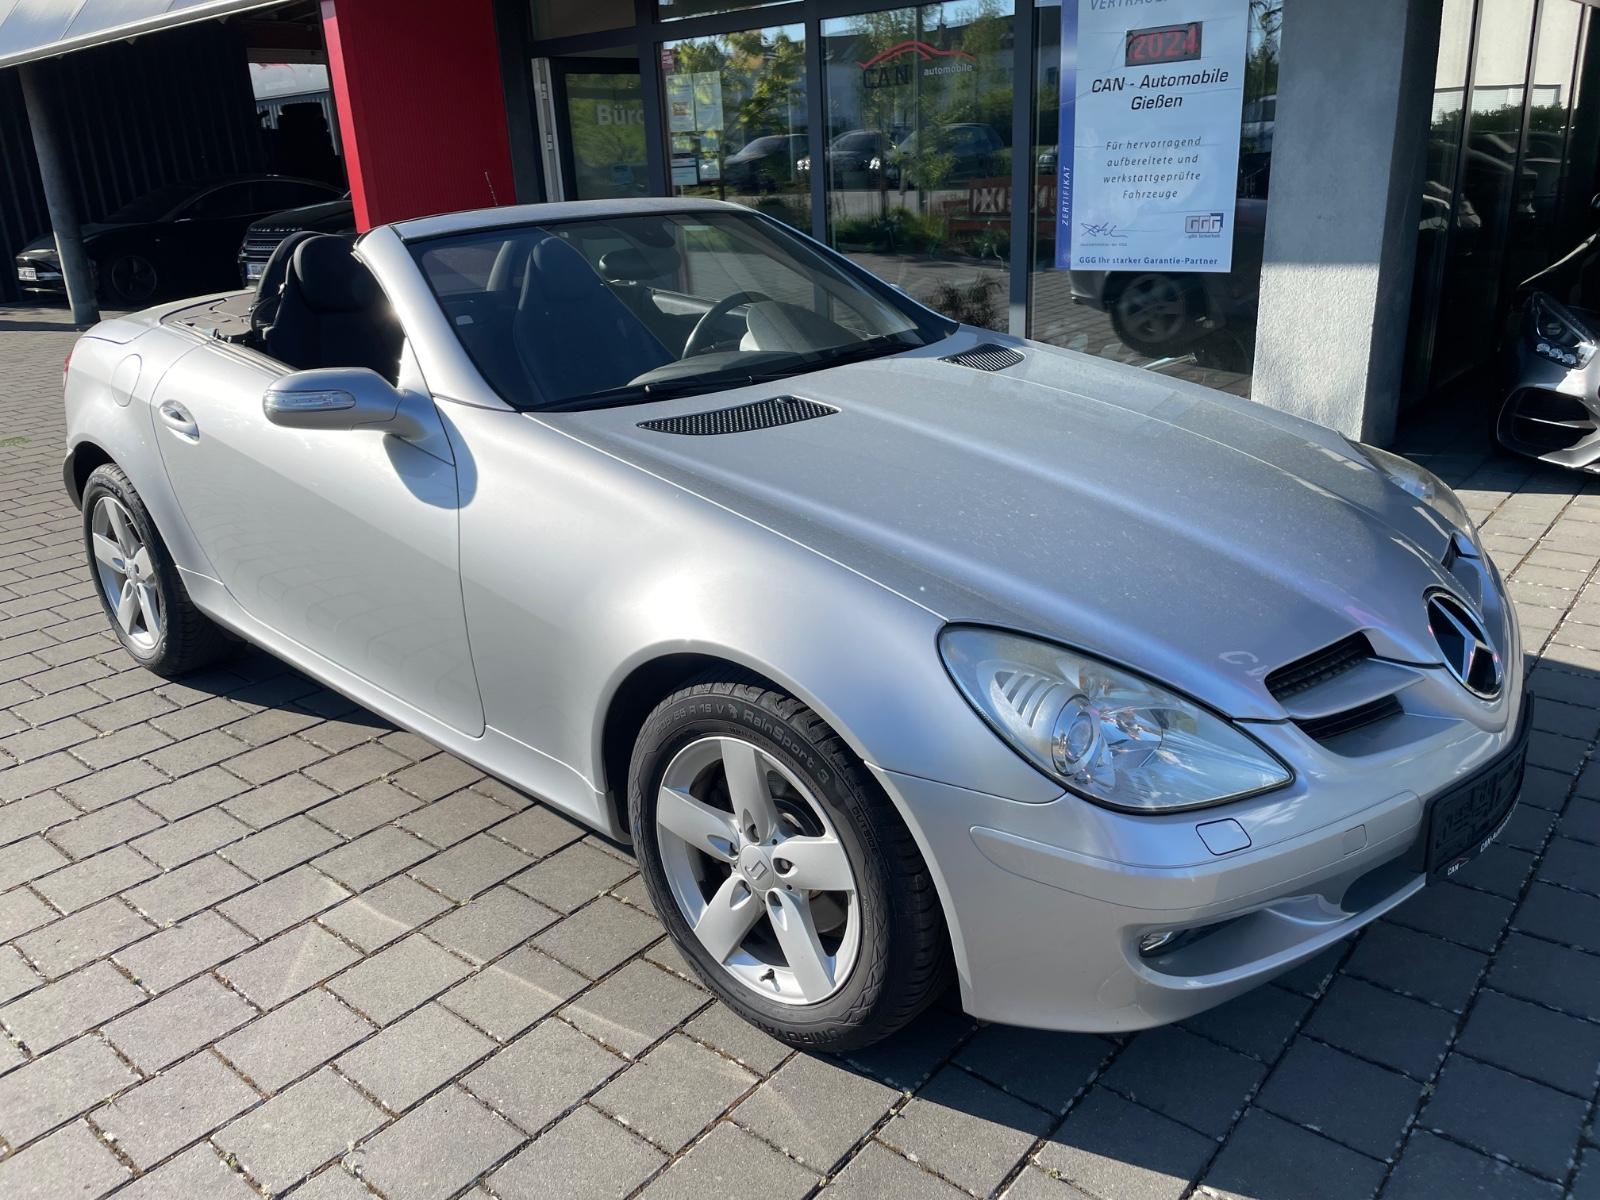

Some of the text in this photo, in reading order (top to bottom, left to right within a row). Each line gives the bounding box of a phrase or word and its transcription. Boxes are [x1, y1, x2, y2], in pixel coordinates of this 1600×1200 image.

[863, 63, 973, 89] CAN automobile
[1091, 77, 1125, 93] CAN
[1139, 69, 1229, 89] Automobile
[1131, 95, 1183, 110] Gießen
[1106, 136, 1202, 151] Für hervorragend
[1106, 154, 1199, 167] aufbereitete und
[1103, 171, 1201, 184] werkstattgeprüfte
[1061, 166, 1070, 226] ZERTIFIKAT
[1122, 189, 1178, 200] Fahrzeuge
[1112, 257, 1142, 265] starker
[1143, 257, 1218, 265] Garantie-Partner
[743, 709, 815, 768] RainSport
[816, 768, 830, 784] 3
